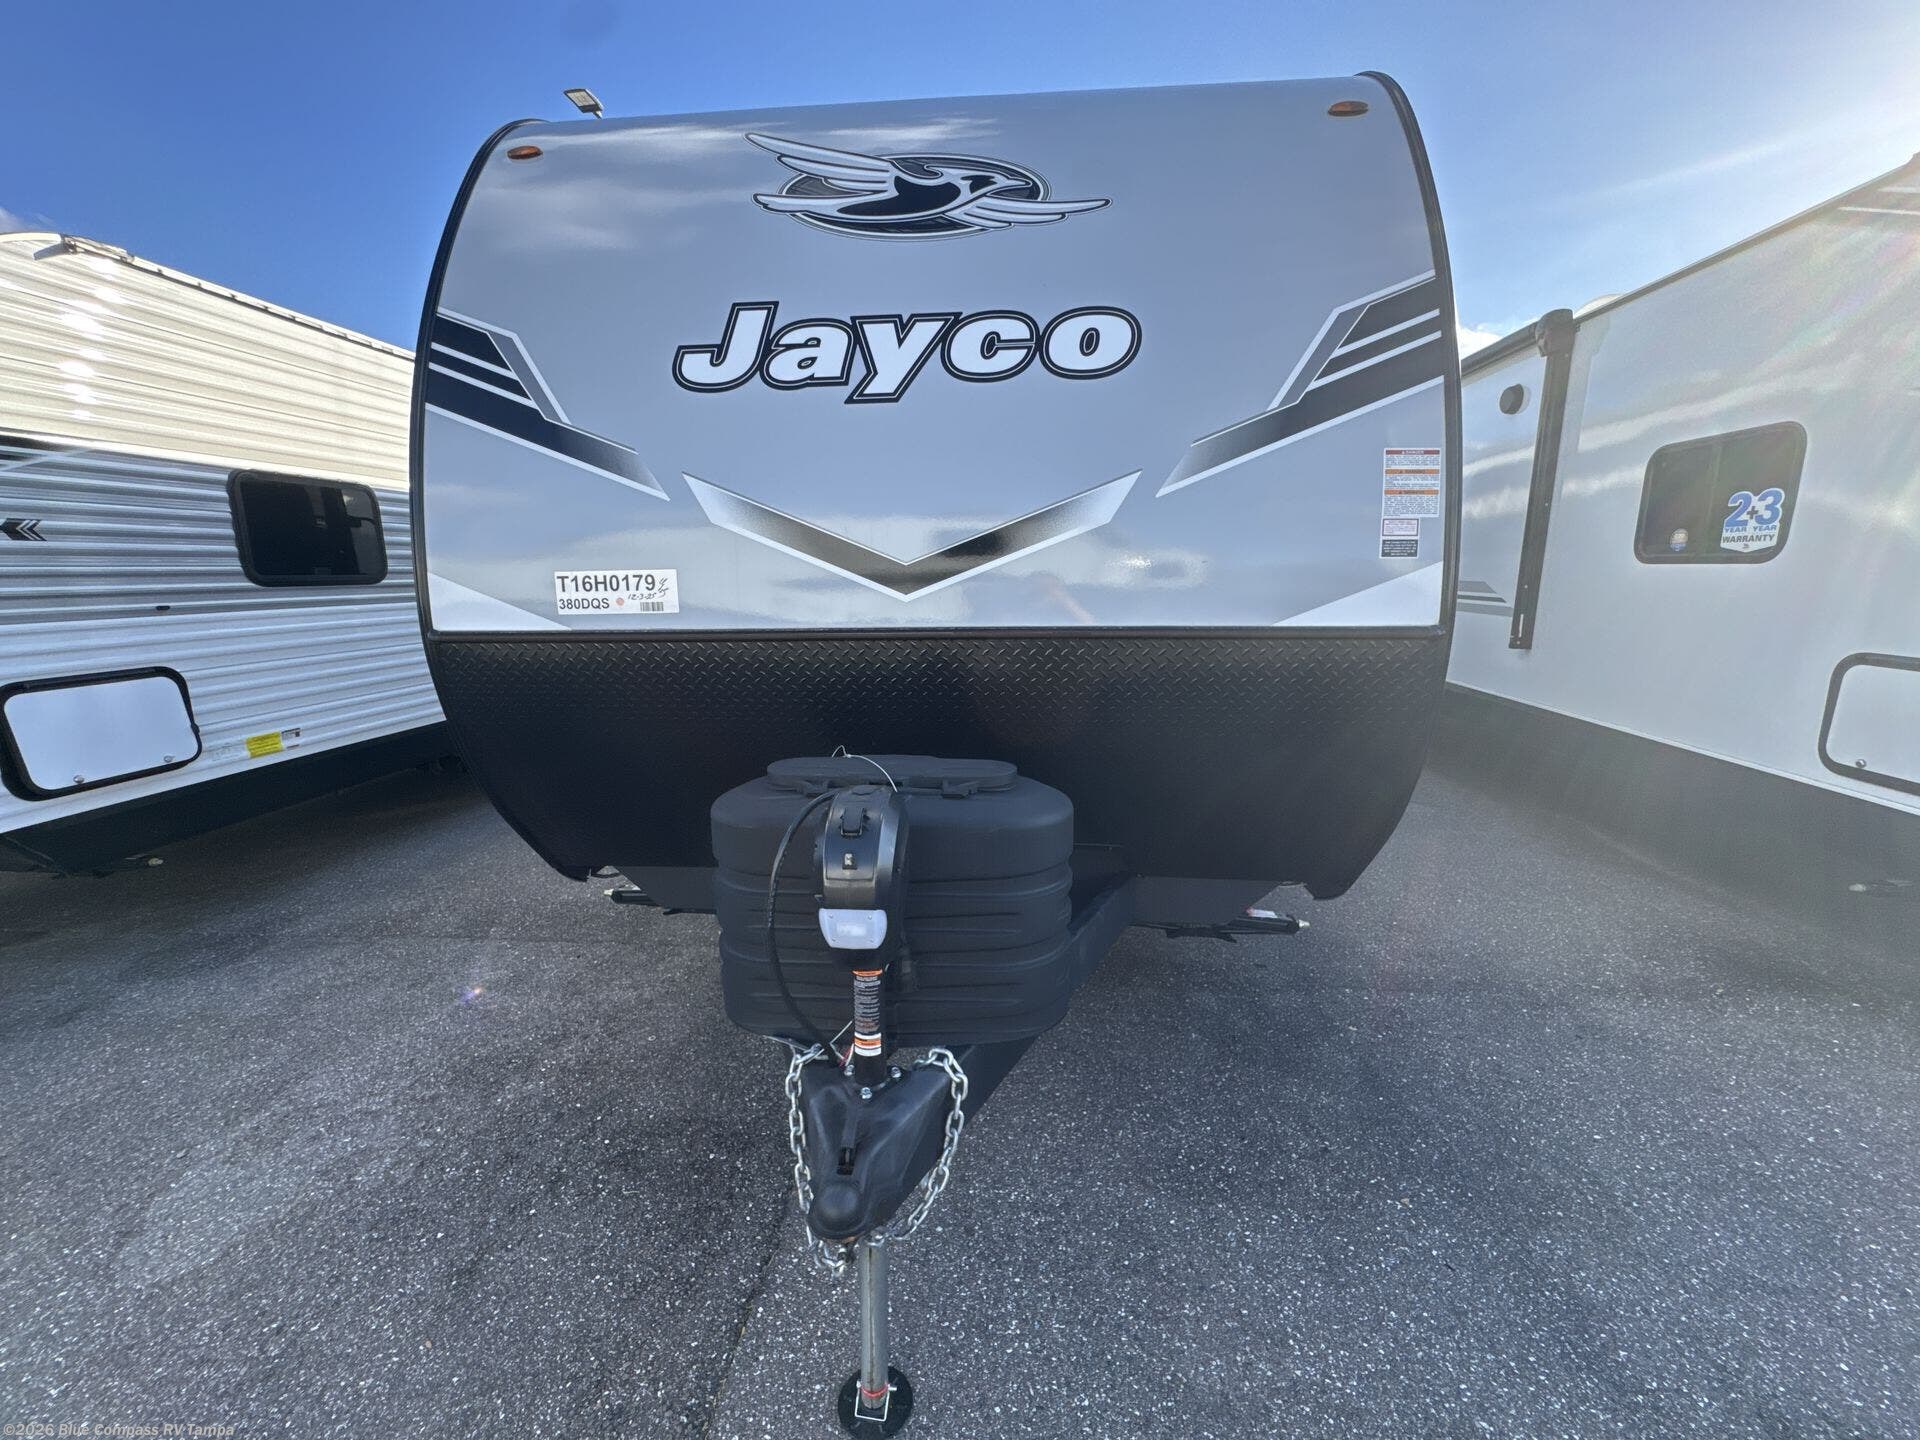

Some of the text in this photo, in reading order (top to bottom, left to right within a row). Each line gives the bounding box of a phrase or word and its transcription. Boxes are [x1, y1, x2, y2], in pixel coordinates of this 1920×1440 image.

[672, 301, 1142, 404] Jayco
[1722, 534, 1775, 544] WARRANTY
[556, 574, 656, 592] T16H0179
[559, 598, 610, 610] 380DQS
